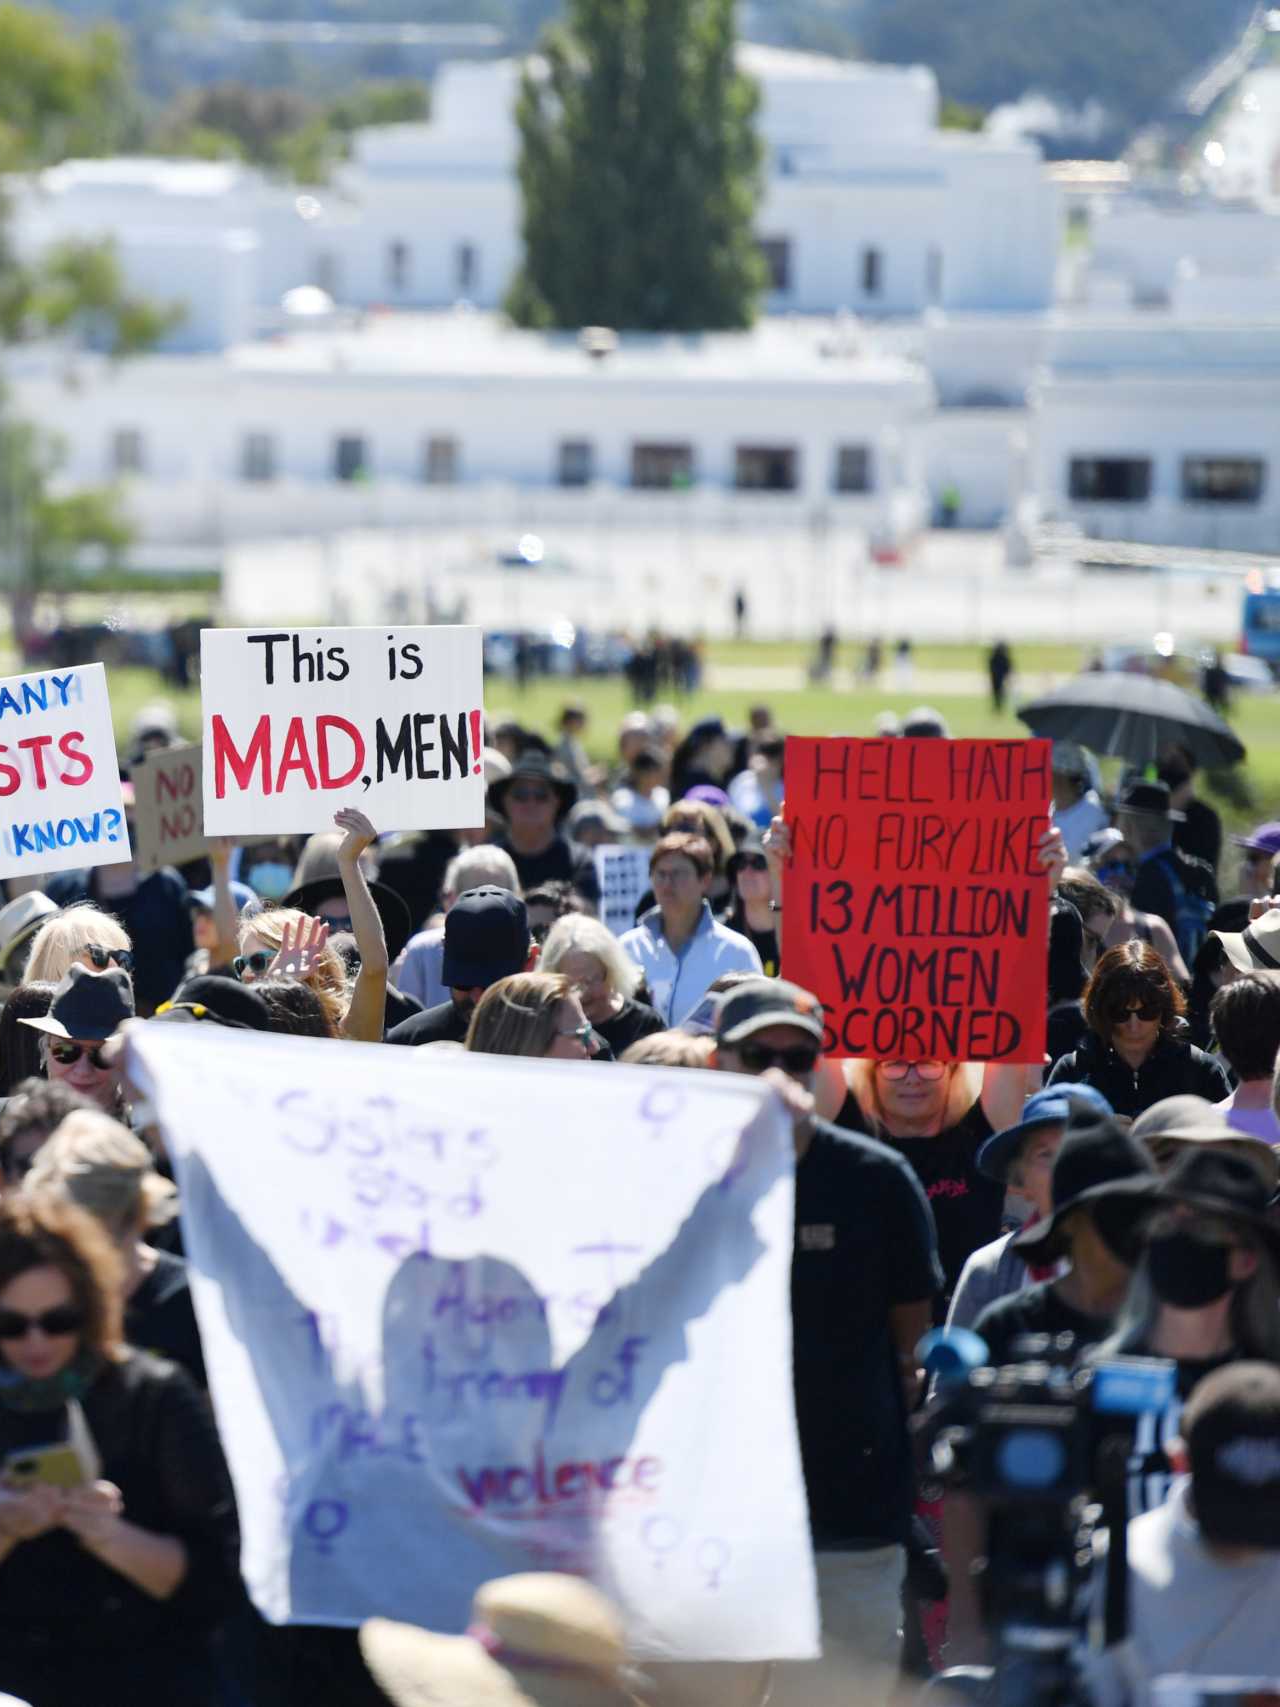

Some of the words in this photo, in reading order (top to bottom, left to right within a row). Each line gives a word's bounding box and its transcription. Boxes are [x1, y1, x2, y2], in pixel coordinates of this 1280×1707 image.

[247, 633, 350, 685] This
[387, 634, 424, 681] is
[155, 763, 195, 803] NO
[812, 741, 934, 803] HELL
[948, 741, 1048, 802] HATH
[11, 808, 121, 856] KNOW?
[159, 803, 196, 847] NO
[788, 813, 848, 872] NO
[874, 812, 968, 873] FURY
[969, 814, 1054, 877] LIKE
[810, 879, 854, 935] 13
[863, 884, 1031, 938] MILLION
[831, 943, 1001, 1007] WOMEN
[820, 1003, 1023, 1061] SCORNED
